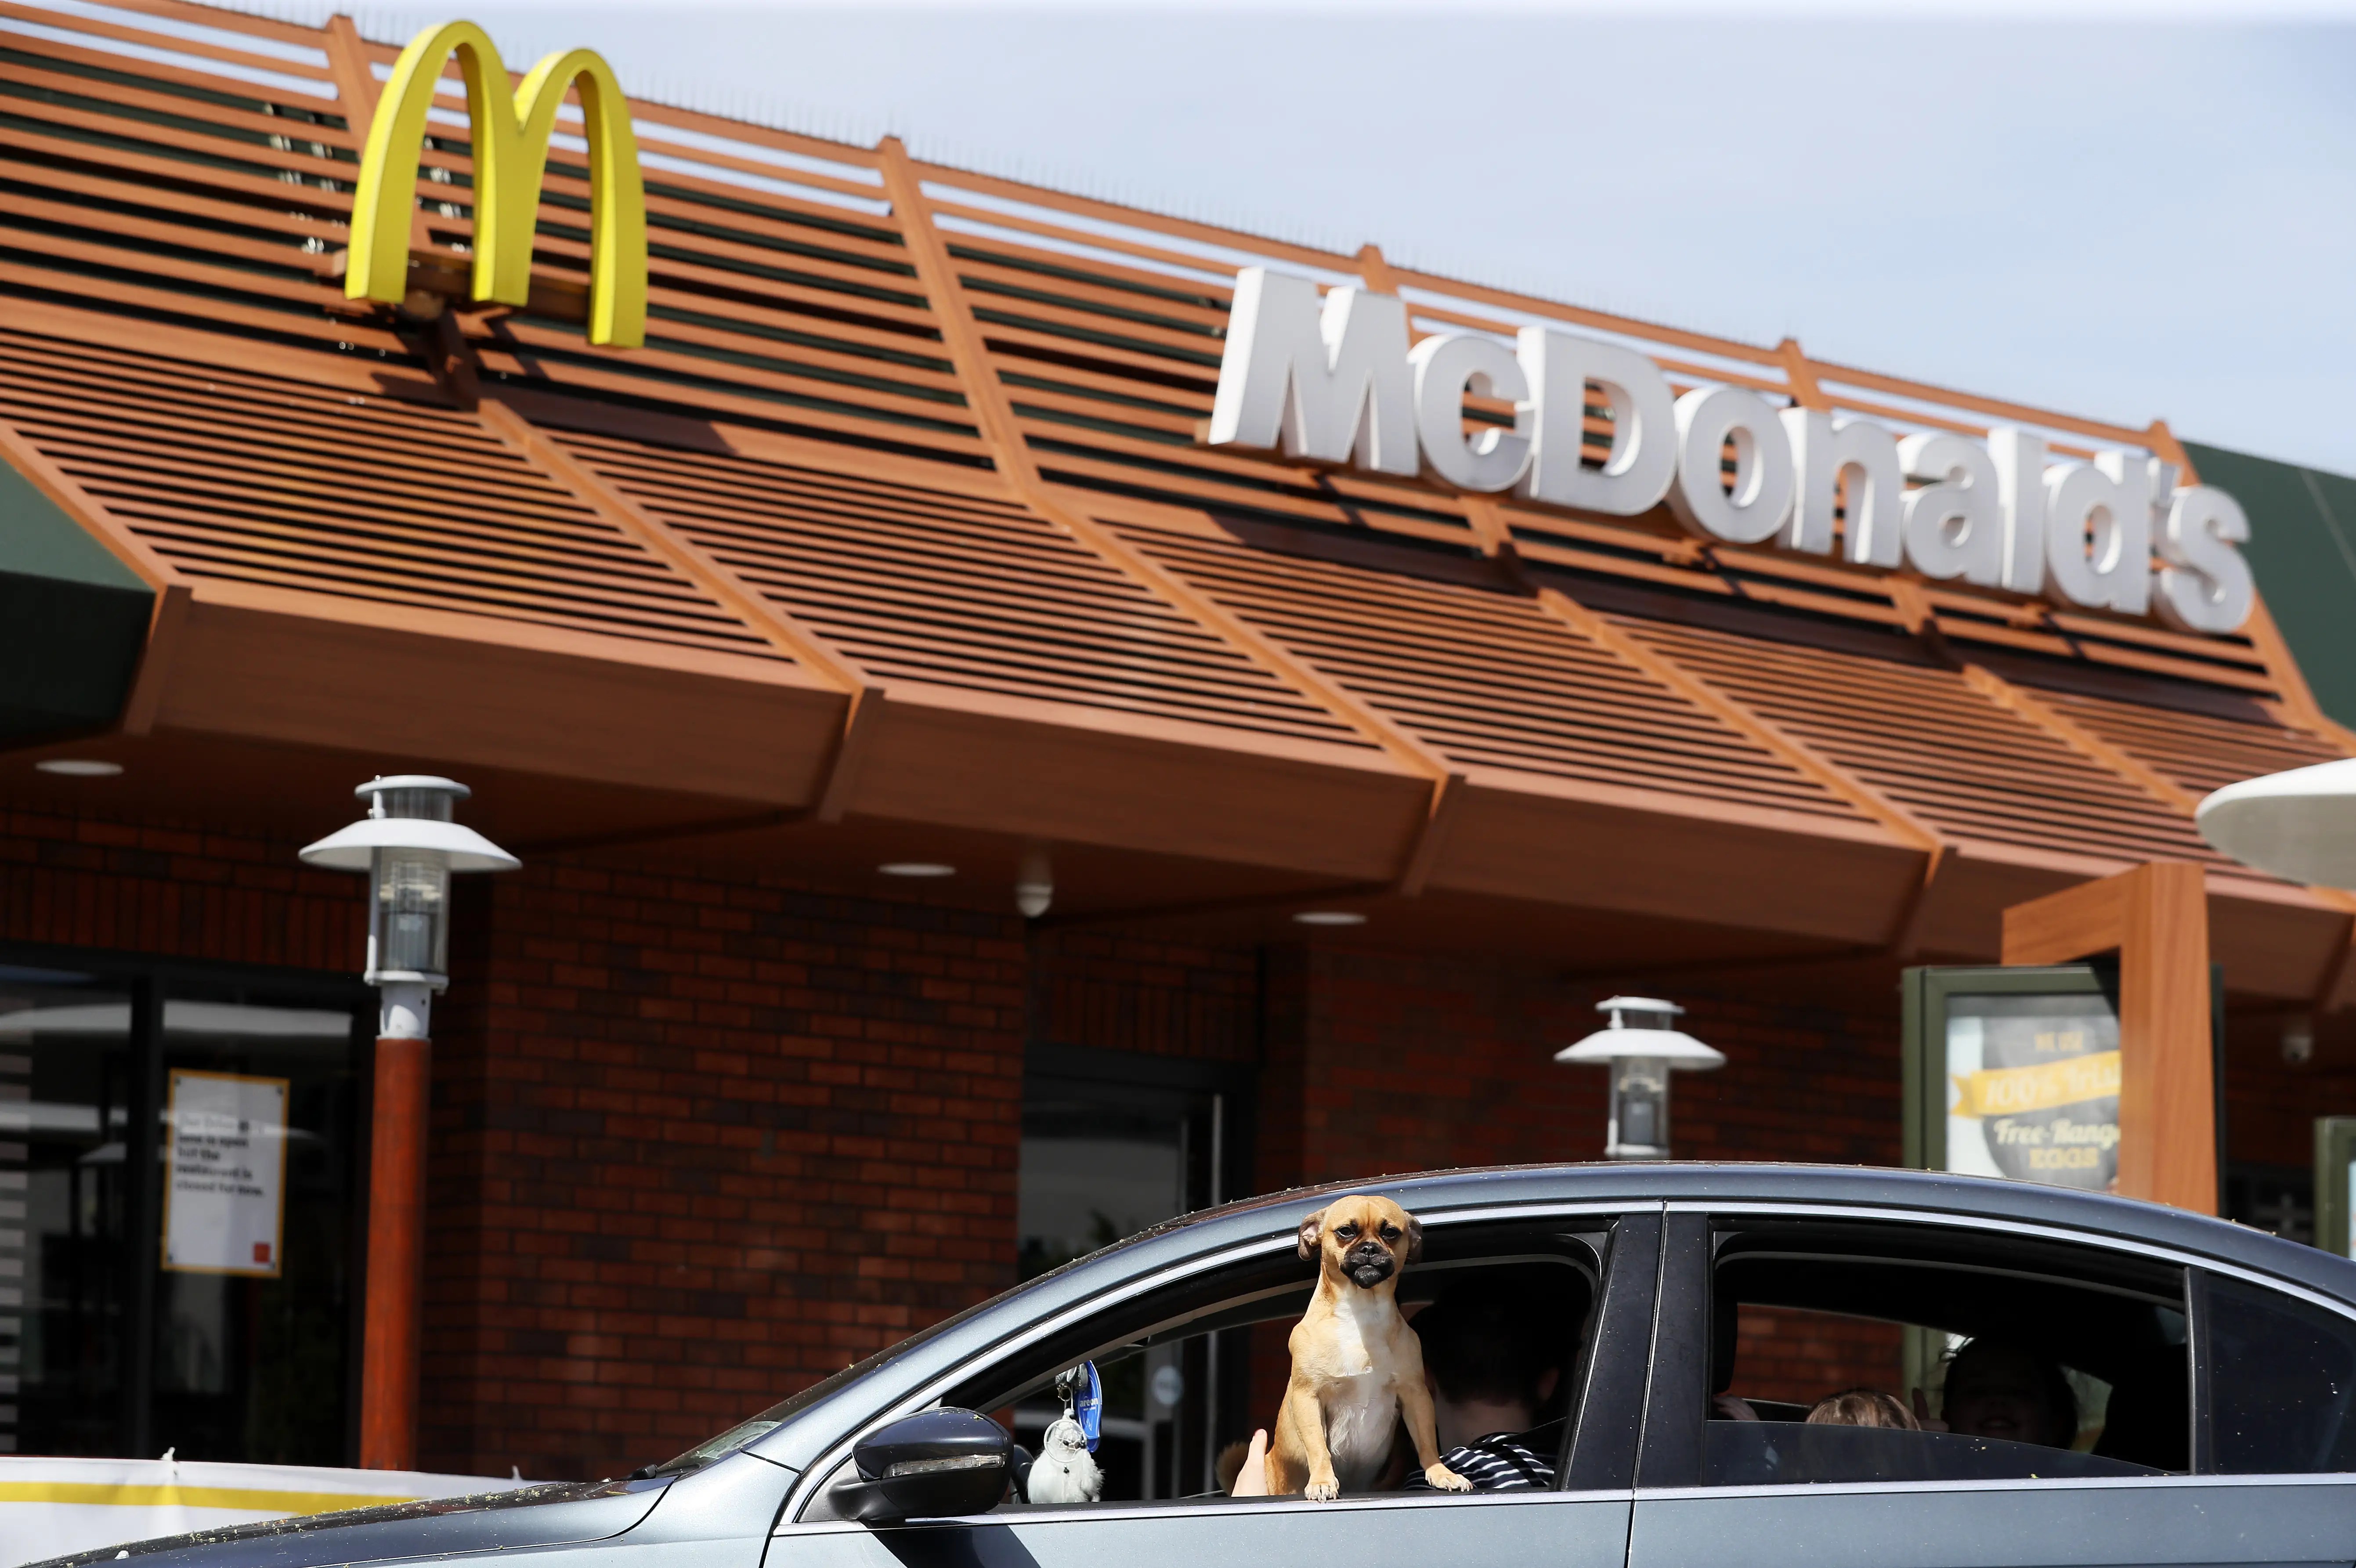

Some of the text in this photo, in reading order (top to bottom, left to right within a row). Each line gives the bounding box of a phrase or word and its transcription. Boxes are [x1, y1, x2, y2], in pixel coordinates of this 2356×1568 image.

[1209, 266, 2253, 632] McDonald's
[1986, 1074, 2059, 1106] 100%
[2029, 1147, 2099, 1170] EGGS
[1080, 1398, 1098, 1407] areon
